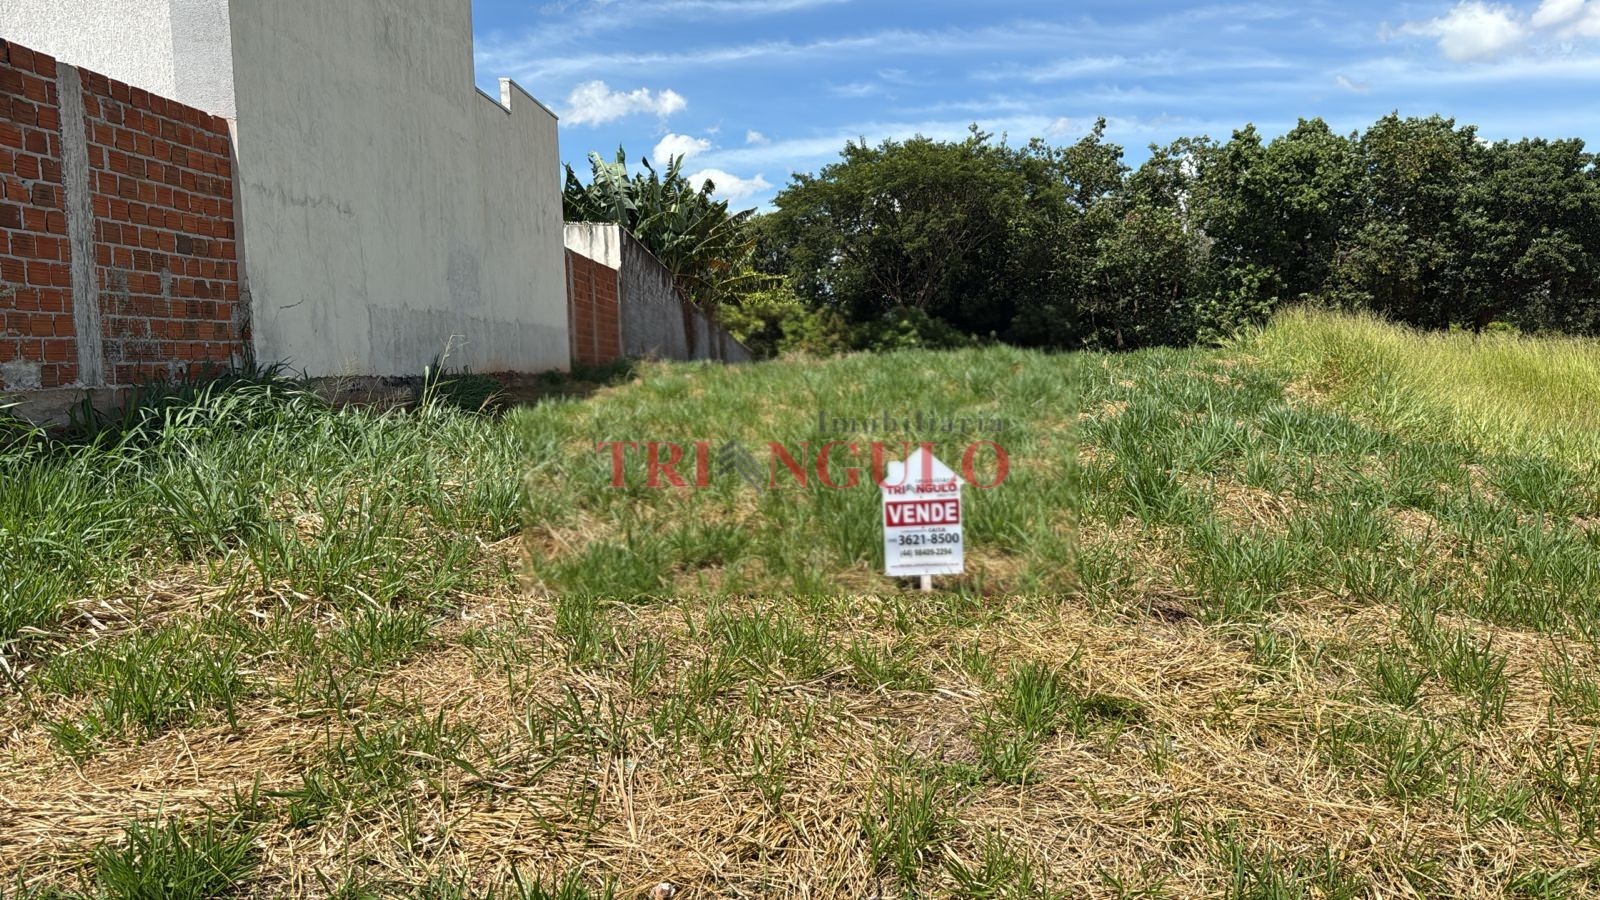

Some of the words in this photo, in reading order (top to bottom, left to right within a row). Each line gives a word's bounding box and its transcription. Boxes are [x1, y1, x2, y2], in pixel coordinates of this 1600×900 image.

[888, 502, 957, 524] VENDE
[898, 533, 960, 546] 3621-8500
[900, 550, 912, 558] (44)
